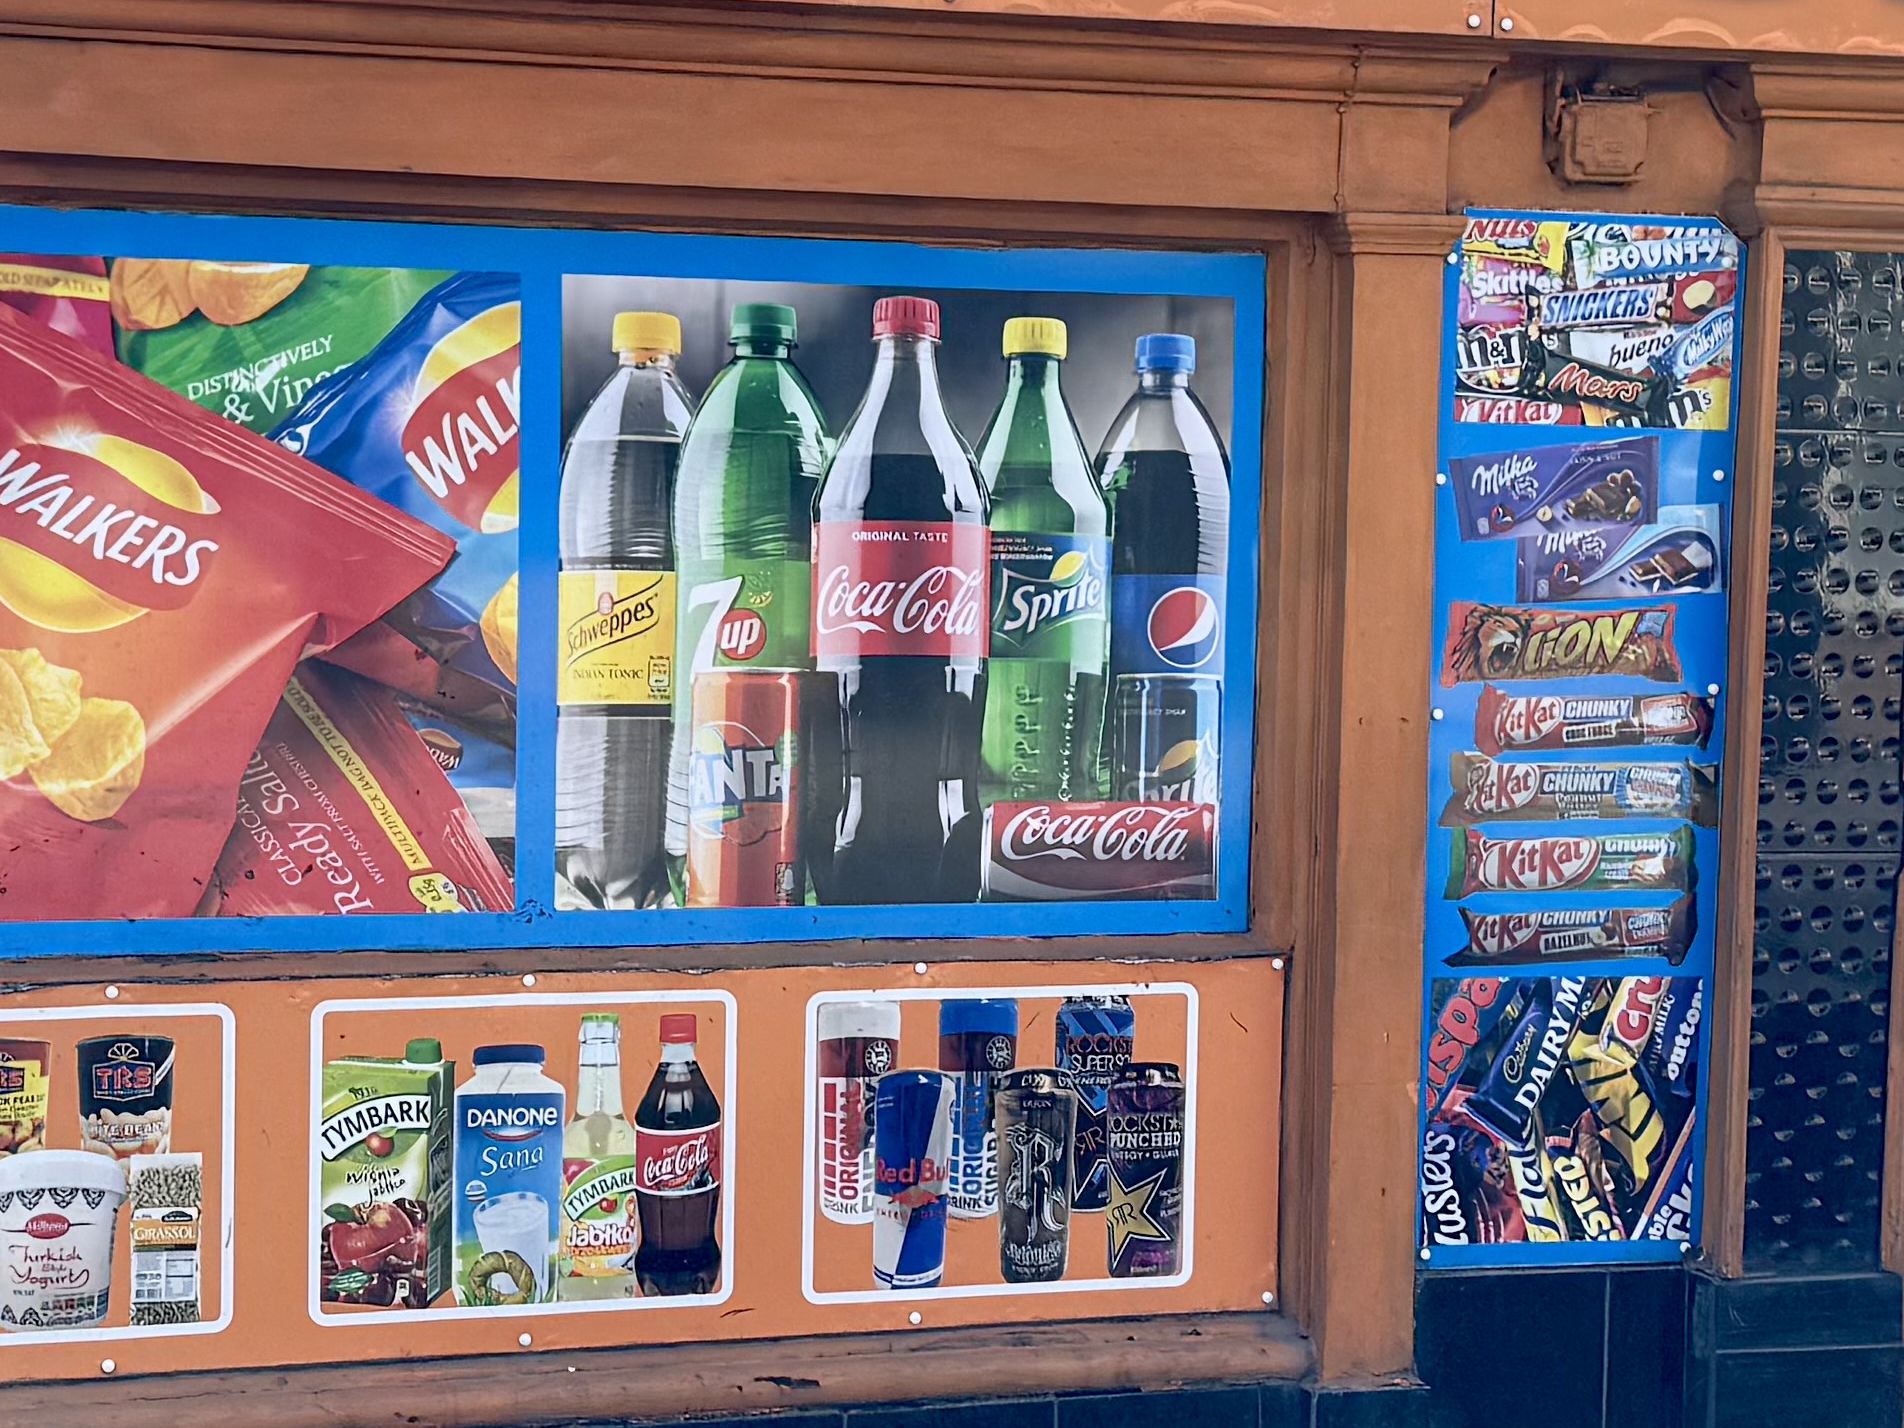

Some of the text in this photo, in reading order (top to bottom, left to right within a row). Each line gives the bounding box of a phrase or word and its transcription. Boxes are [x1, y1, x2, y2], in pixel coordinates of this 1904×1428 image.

[1599, 239, 1722, 271] BOUNTY
[1471, 271, 1565, 299] Skittles
[1545, 287, 1655, 324] SNICKERS
[1610, 331, 1675, 369] bueno
[1547, 362, 1644, 401] Mars
[1472, 454, 1538, 496] Milka
[851, 530, 949, 543] ORIGINAL TASTE
[1004, 568, 1102, 639] Sprite
[567, 593, 657, 657] Schweppes
[1565, 699, 1632, 719] CHUNKY
[690, 748, 790, 804] ANTA
[1542, 772, 1615, 792] CHUNKY
[287, 820, 375, 915] Ready
[1497, 838, 1585, 889] KitKat
[1470, 909, 1612, 953] KitKat CHUNKY
[1514, 1004, 1568, 1110] DAIRY
[95, 1066, 153, 1090] TRS
[321, 1100, 430, 1150] TYMBARK
[481, 1145, 544, 1177] Sana
[567, 1169, 636, 1214] TYMBARK
